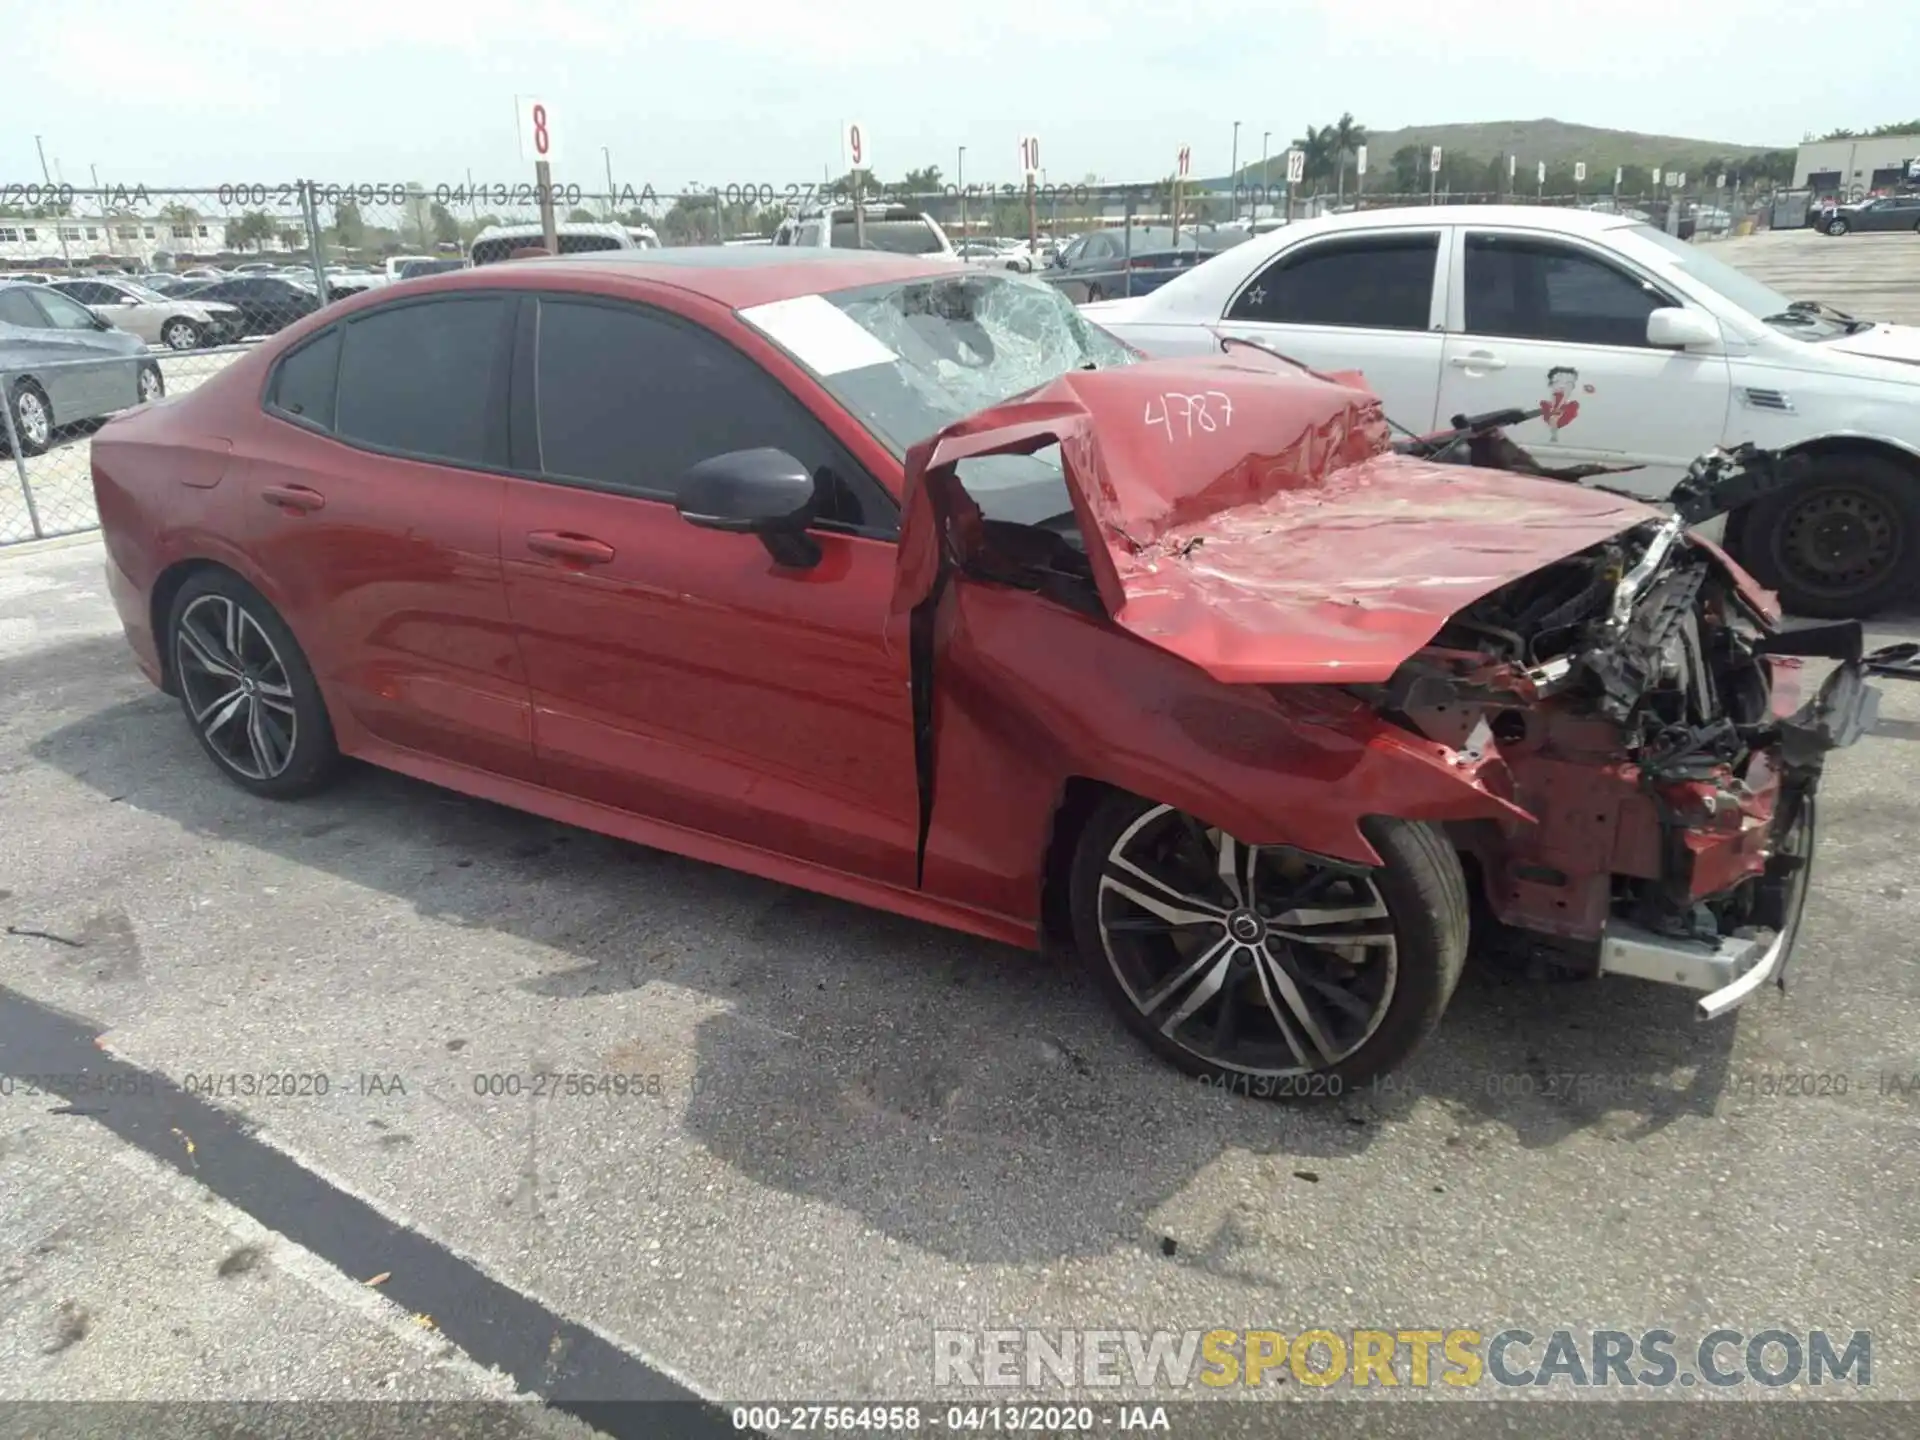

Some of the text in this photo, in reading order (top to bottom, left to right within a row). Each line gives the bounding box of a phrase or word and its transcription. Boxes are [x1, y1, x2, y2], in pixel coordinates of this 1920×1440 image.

[533, 104, 549, 154] 8
[850, 124, 862, 165] 9
[1022, 137, 1040, 171] 10
[1178, 146, 1191, 177] 11
[1289, 153, 1303, 180] 12
[1145, 391, 1233, 442] 4787
